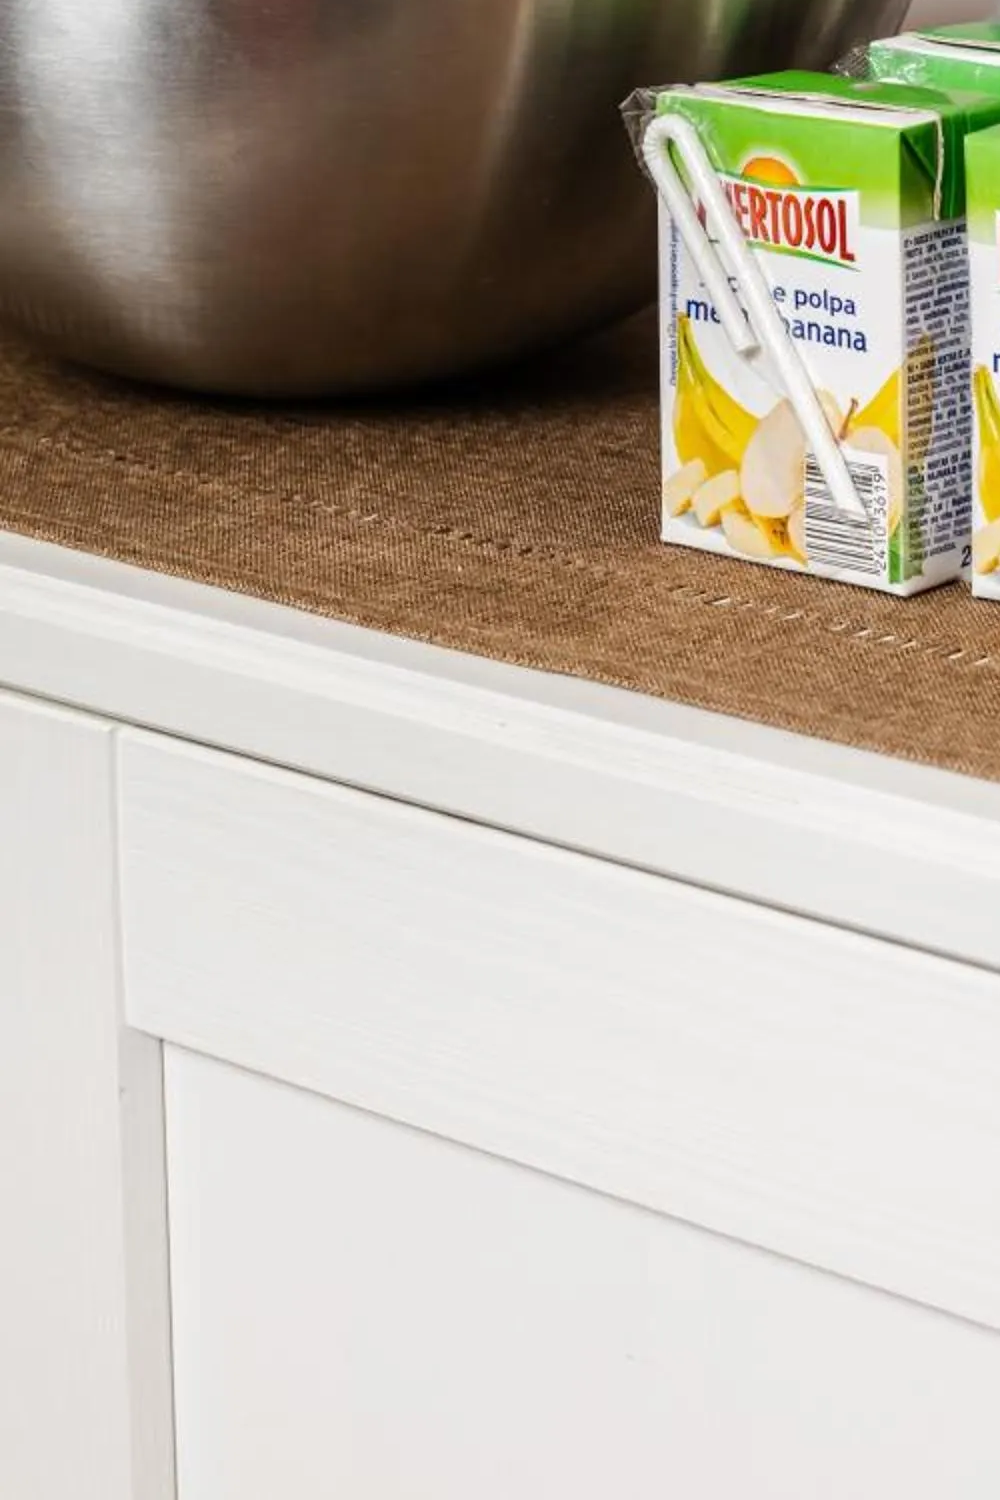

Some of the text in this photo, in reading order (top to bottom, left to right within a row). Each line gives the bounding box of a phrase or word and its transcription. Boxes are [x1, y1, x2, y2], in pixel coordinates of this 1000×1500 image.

[697, 179, 855, 262] ERTOSOL
[773, 286, 856, 317] e polpa
